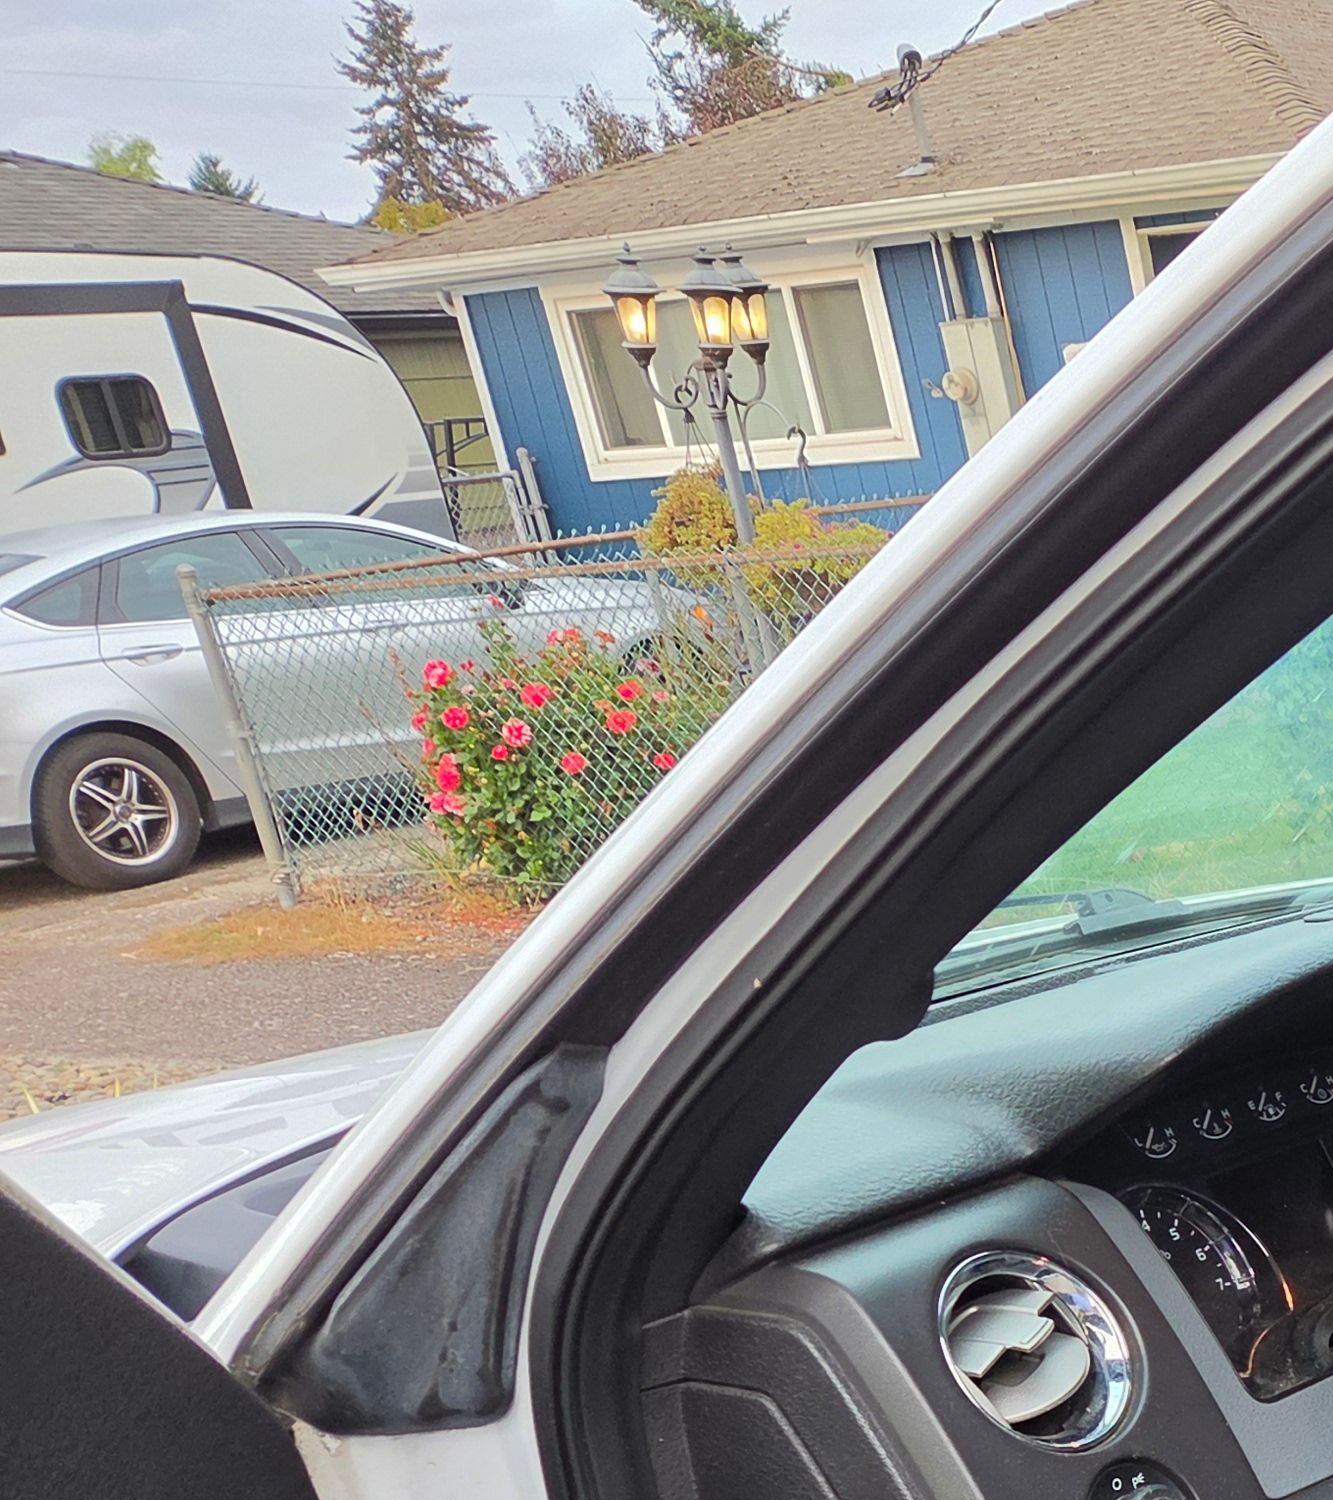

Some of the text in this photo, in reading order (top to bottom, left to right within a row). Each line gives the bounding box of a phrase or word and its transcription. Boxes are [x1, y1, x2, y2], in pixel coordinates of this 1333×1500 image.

[1300, 1083, 1308, 1093] C
[1275, 1092, 1283, 1101] F
[1248, 1101, 1256, 1111] E
[1221, 1108, 1231, 1118] H
[1193, 1118, 1201, 1128] C
[1164, 1127, 1175, 1137] H
[1141, 1219, 1151, 1232] 4
[1169, 1227, 1180, 1241] 5
[1195, 1248, 1207, 1261] 6
[1215, 1277, 1224, 1291] 7
